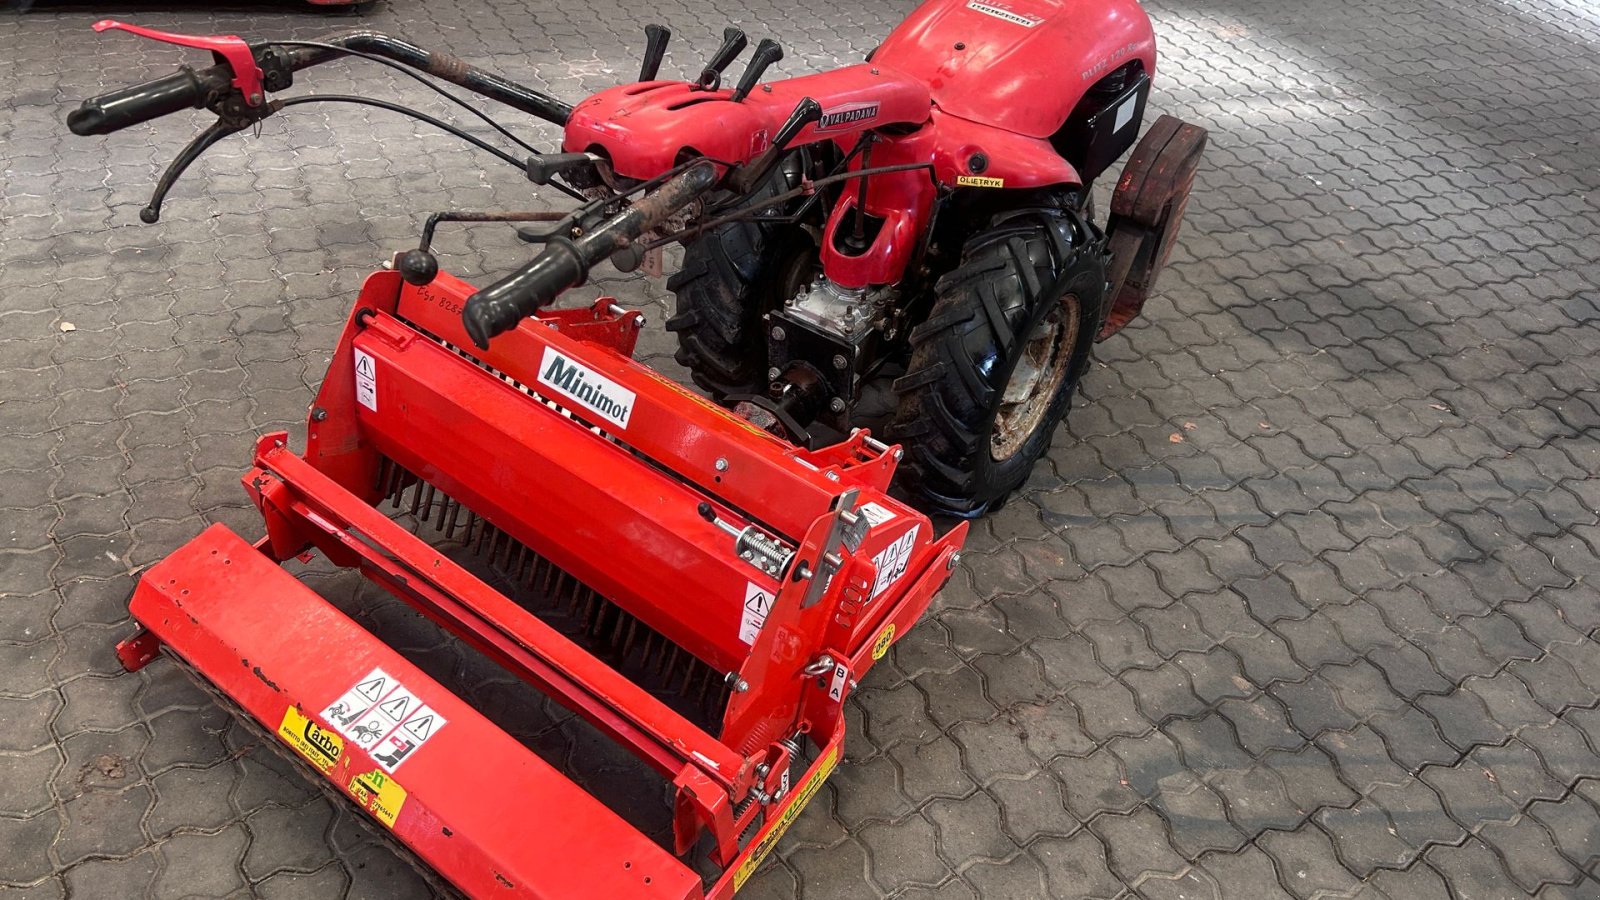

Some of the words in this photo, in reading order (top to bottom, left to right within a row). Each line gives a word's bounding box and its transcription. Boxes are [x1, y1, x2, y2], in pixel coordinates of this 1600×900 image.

[829, 106, 877, 125] VALPADANA
[959, 176, 1001, 187] OLIETRYK
[543, 355, 628, 422] Minimot
[836, 667, 845, 678] B
[831, 687, 839, 698] A
